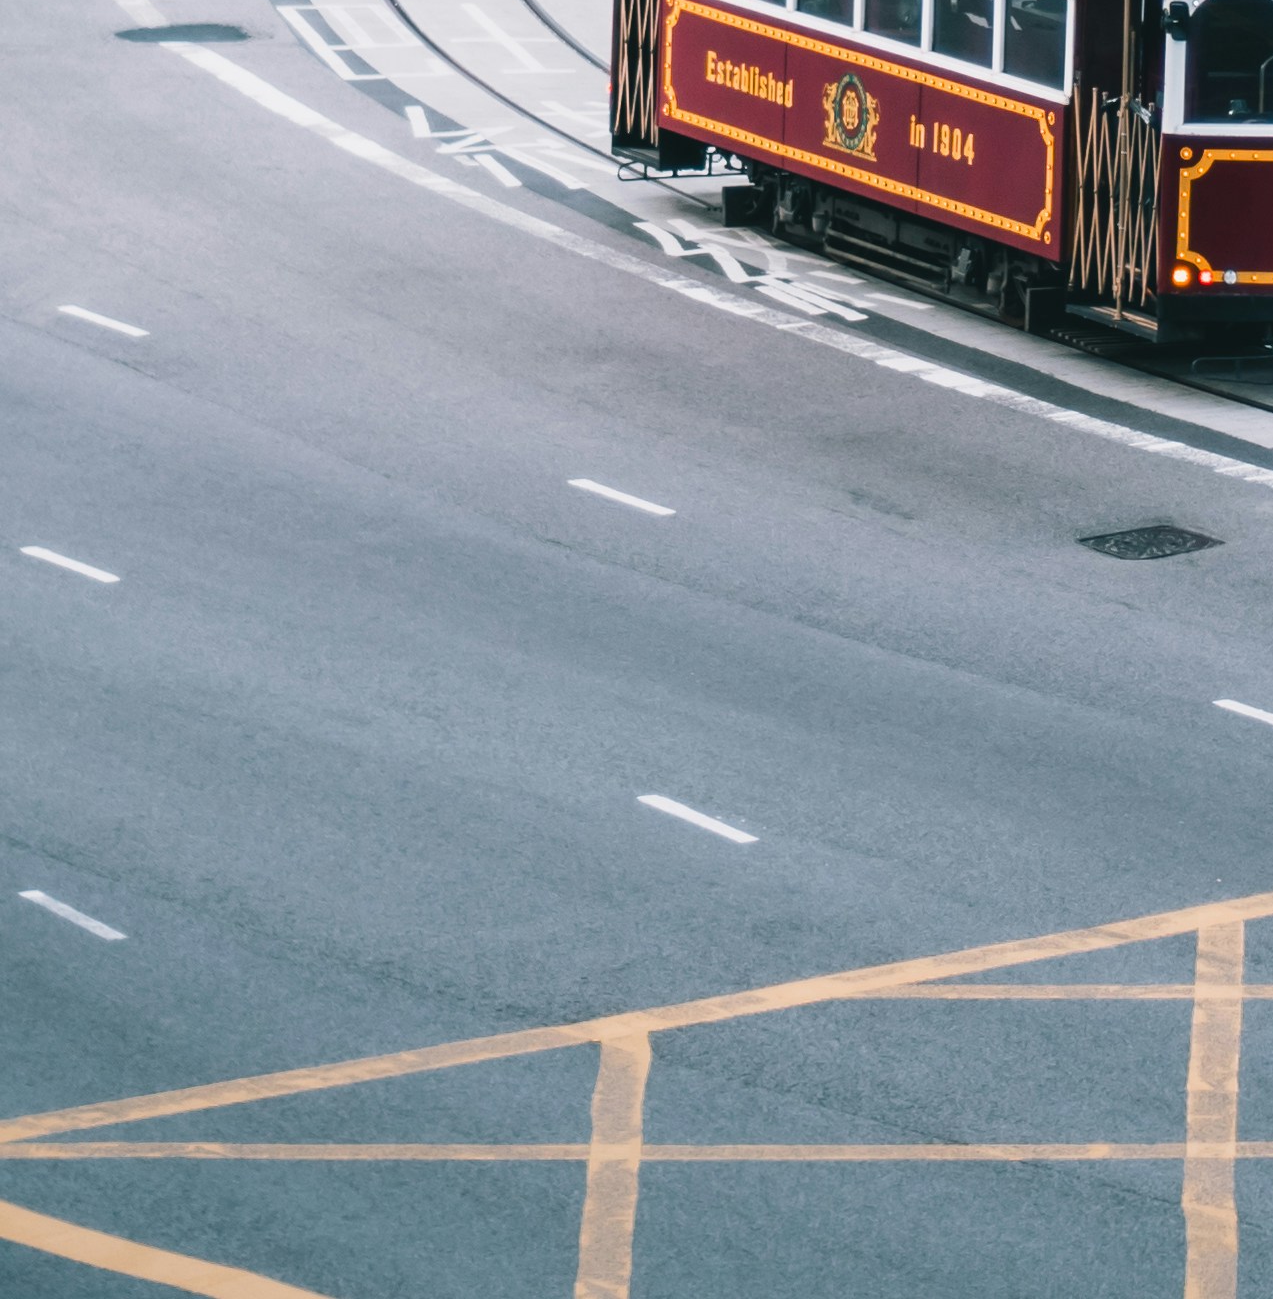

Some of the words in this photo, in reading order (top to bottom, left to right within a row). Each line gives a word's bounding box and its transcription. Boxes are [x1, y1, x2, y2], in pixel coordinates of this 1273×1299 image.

[706, 50, 793, 109] Established
[910, 114, 926, 150] in
[933, 121, 975, 166] 1904
